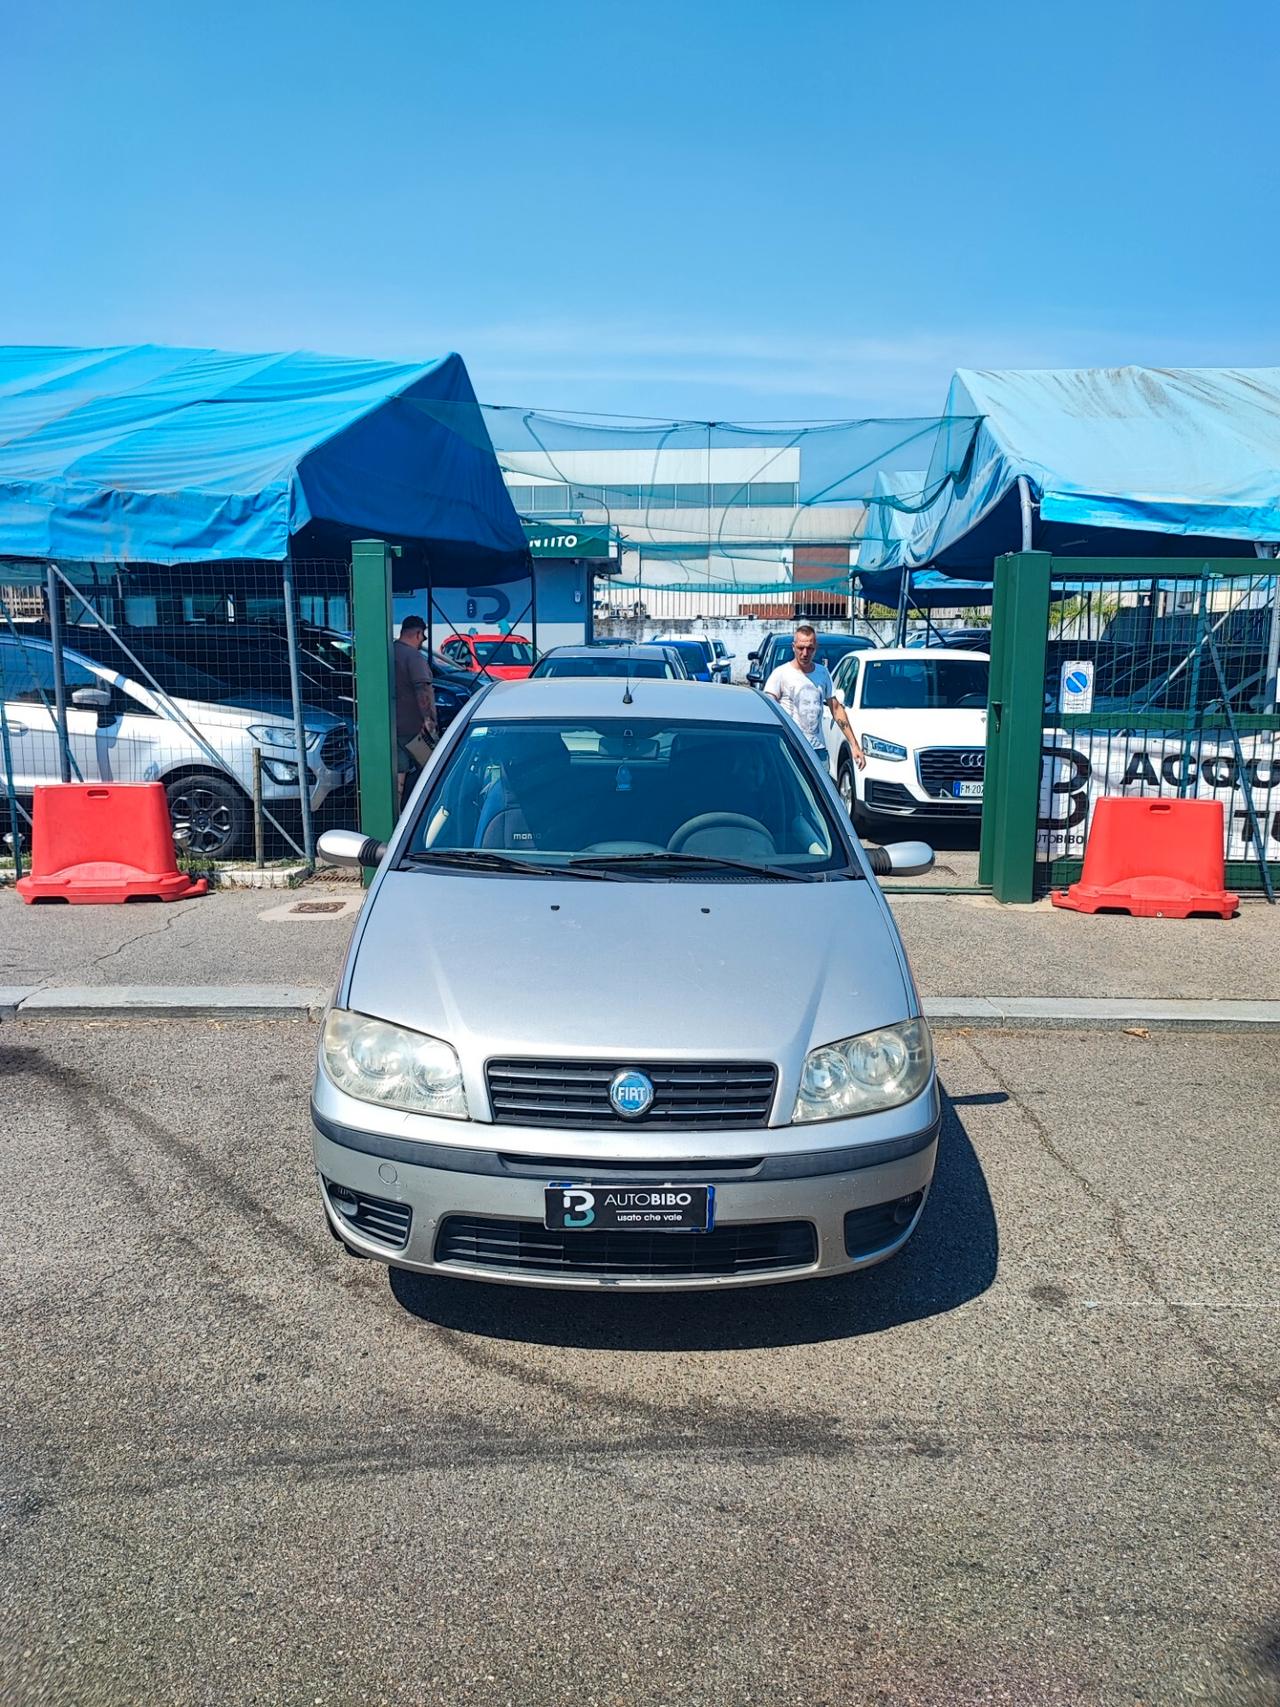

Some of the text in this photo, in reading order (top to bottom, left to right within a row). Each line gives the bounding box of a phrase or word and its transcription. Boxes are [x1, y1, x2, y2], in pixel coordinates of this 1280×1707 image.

[1036, 834, 1084, 845] UTOBIBO
[618, 1086, 647, 1101] FIAT
[604, 1193, 692, 1206] AUTOBIBO
[617, 1213, 683, 1222] usato che vale
